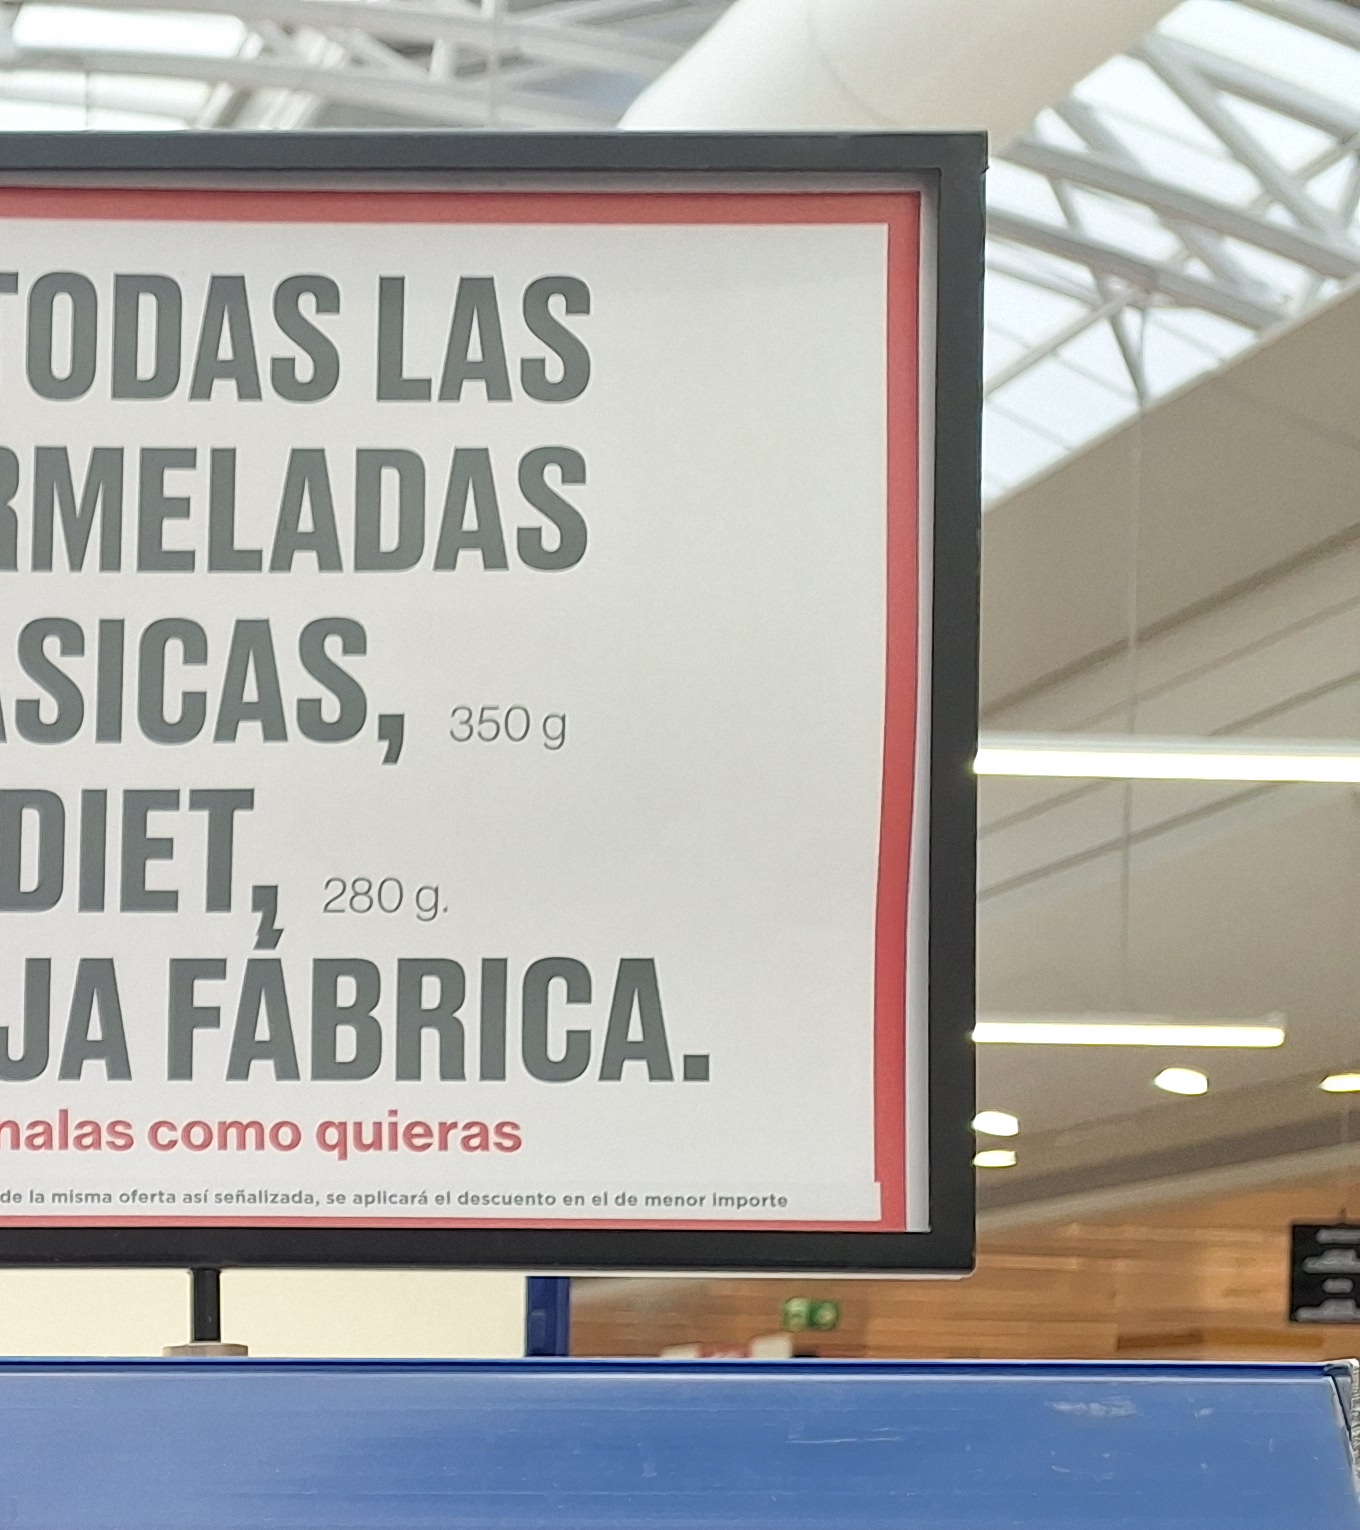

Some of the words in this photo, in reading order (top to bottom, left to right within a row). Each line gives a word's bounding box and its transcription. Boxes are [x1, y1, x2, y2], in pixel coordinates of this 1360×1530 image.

[376, 276, 590, 402] LAS
[450, 706, 530, 742] 350
[543, 714, 565, 750] g
[323, 878, 403, 913] 280
[416, 886, 447, 921] g.
[165, 925, 710, 1084] FÁBRICA.
[148, 1121, 301, 1151] como
[316, 1110, 522, 1160] quieras
[0, 1190, 22, 1203] de
[30, 1190, 44, 1203] la
[52, 1190, 111, 1203] misma
[119, 1189, 175, 1203] oferta
[183, 1189, 208, 1203] así
[215, 1189, 319, 1206] señalizada,
[327, 1194, 346, 1204] se
[353, 1191, 427, 1207] aplicará
[435, 1191, 450, 1205] el
[458, 1191, 556, 1205] descuento
[563, 1196, 584, 1206] en
[592, 1192, 607, 1206] el
[615, 1192, 637, 1206] de
[645, 1196, 705, 1206] menor
[713, 1193, 787, 1209] importe
